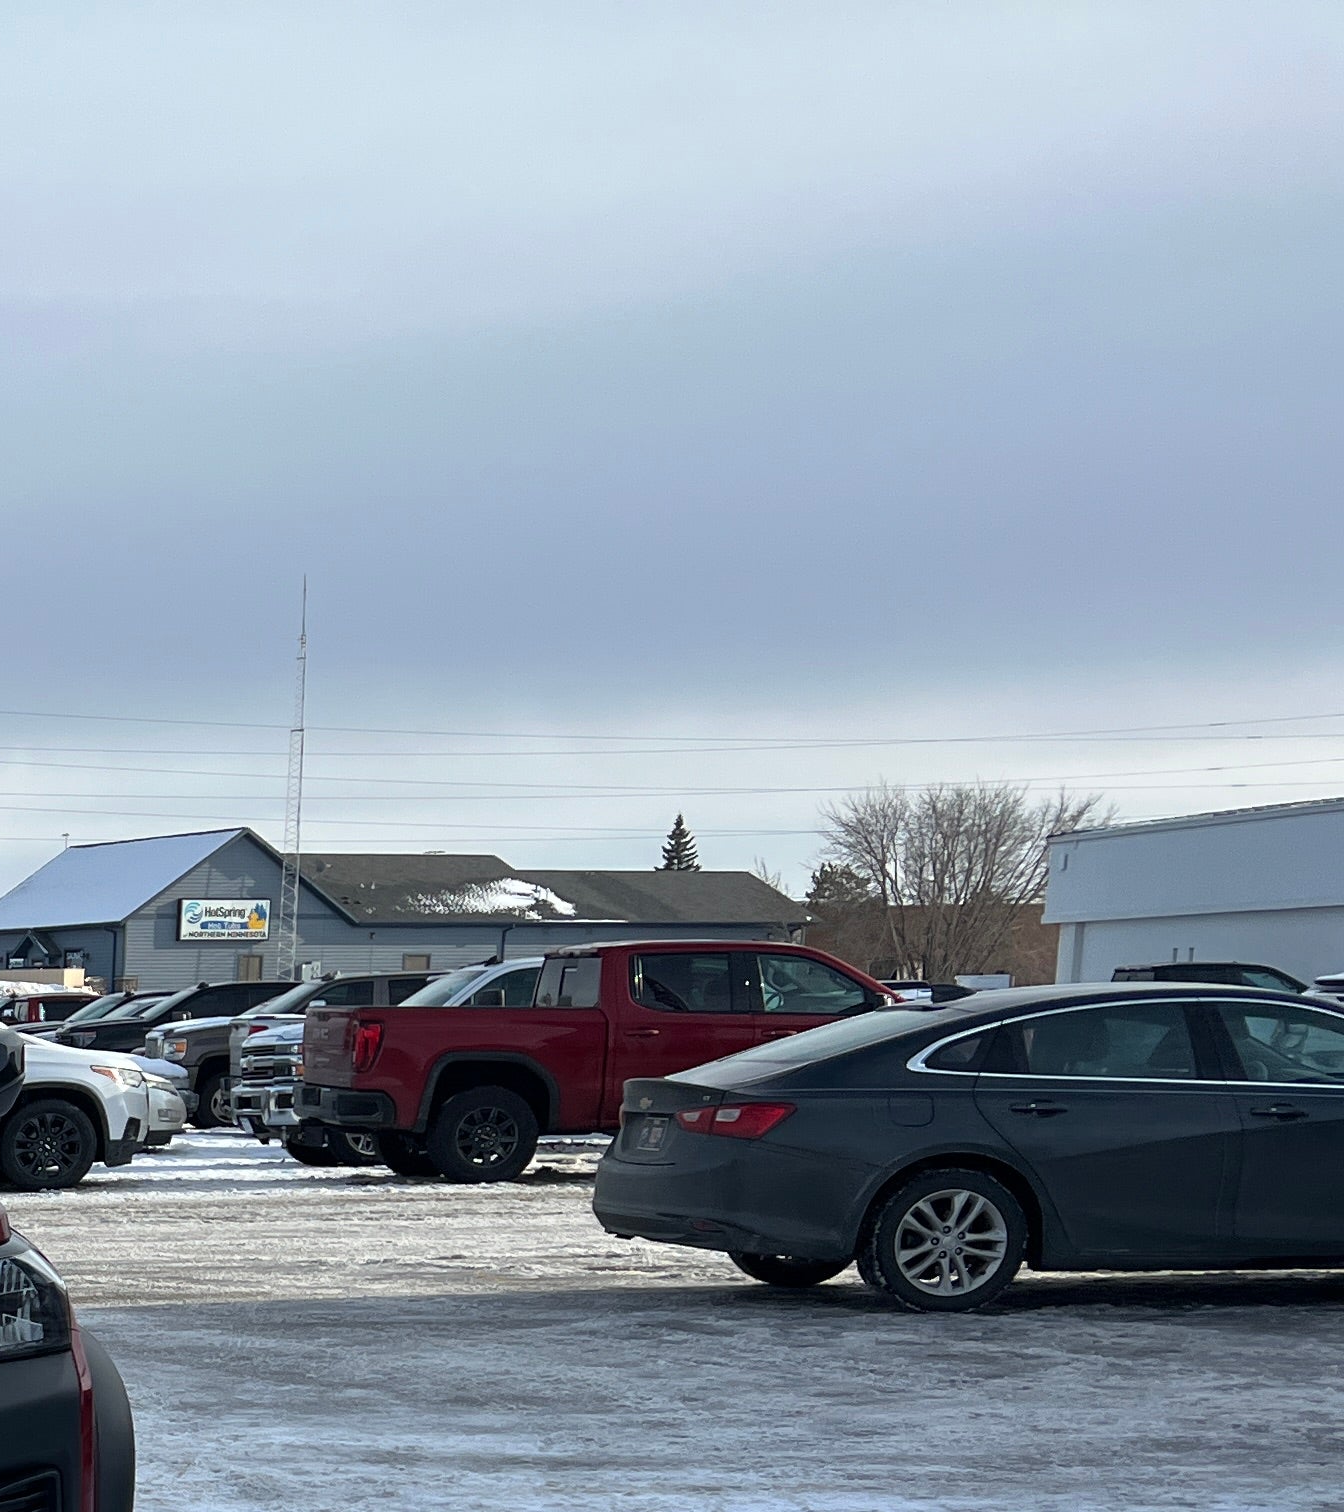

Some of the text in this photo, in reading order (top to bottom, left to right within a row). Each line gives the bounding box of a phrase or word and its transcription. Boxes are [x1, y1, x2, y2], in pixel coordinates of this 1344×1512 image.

[204, 906, 246, 919] HotSpring
[188, 931, 226, 939] NORTHERN
[227, 931, 267, 939] MINNESOTA
